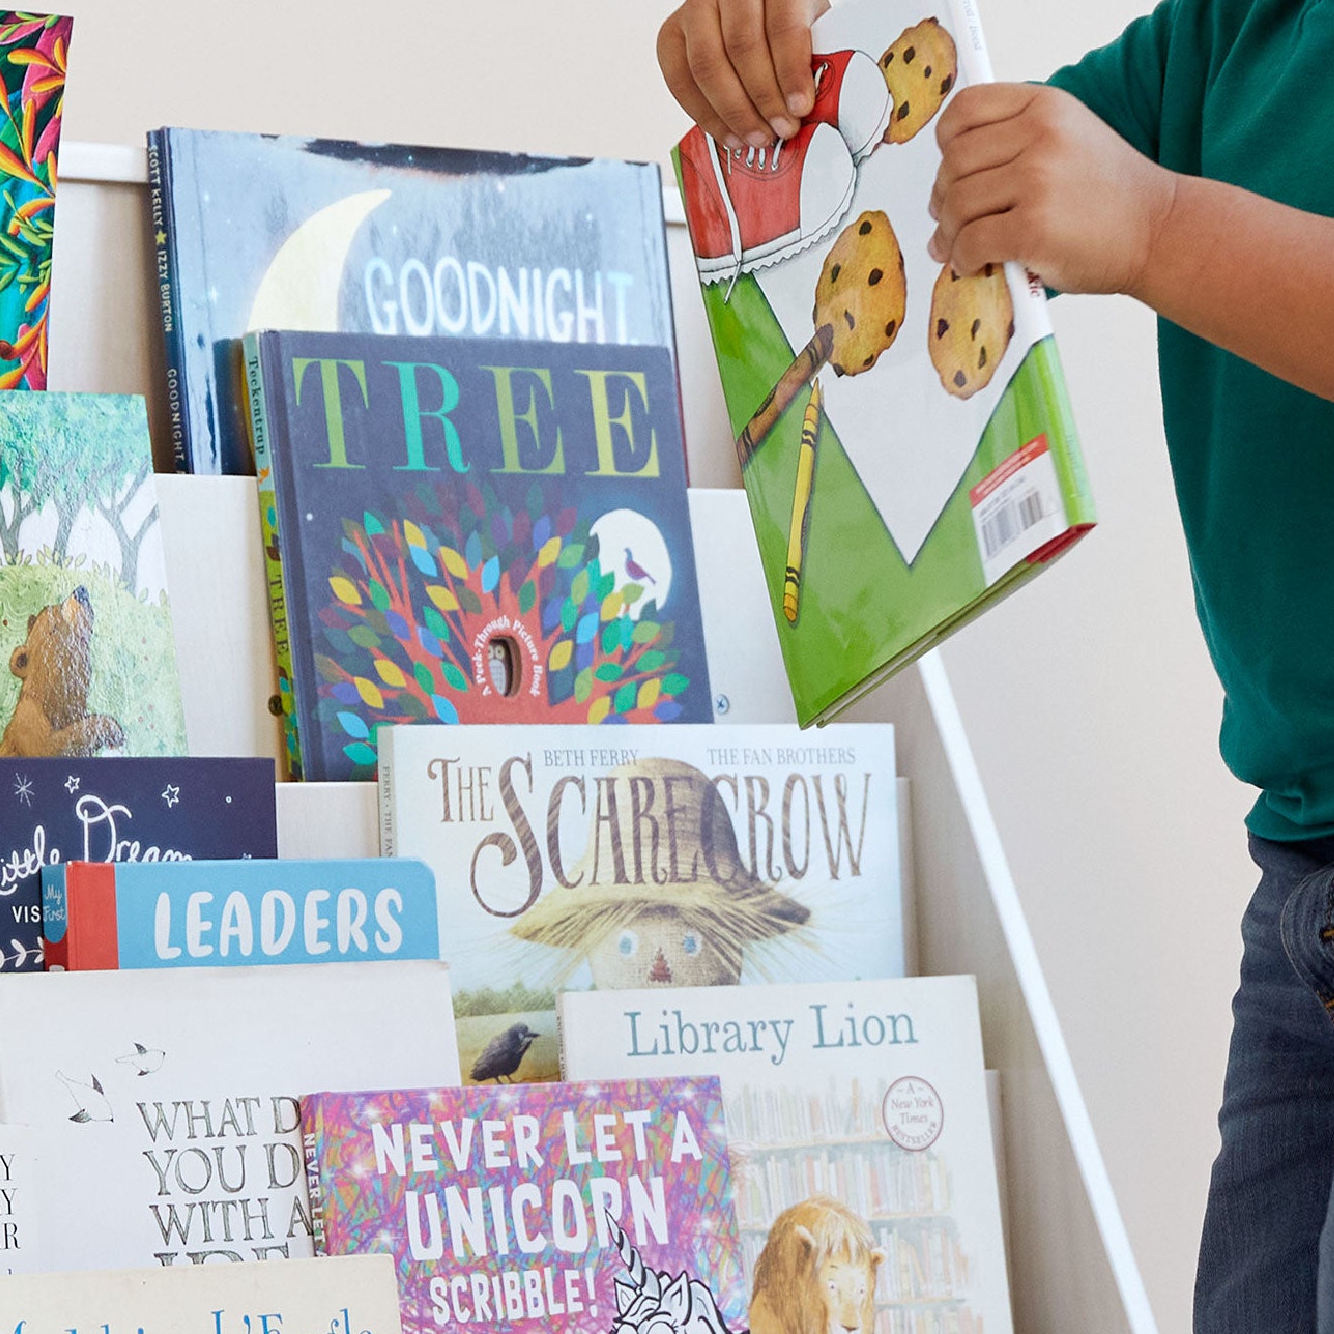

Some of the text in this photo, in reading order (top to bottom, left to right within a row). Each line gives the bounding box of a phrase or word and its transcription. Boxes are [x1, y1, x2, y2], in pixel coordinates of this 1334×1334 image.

[148, 145, 173, 332] SCOTT KELLY IZZY BURTON
[166, 368, 185, 461] GOODNIGHT
[249, 357, 264, 455] Teckentrup
[291, 356, 661, 479] TREE
[269, 573, 290, 655] TREE
[482, 685, 492, 697] A
[511, 618, 540, 662] Picture
[529, 665, 543, 697] Book
[543, 748, 640, 768] BETH FERRY
[707, 748, 856, 765] THE FAN BROTHERS
[468, 751, 874, 919] SCARECROW
[11, 904, 41, 924] VIS
[42, 904, 66, 923] First
[44, 883, 63, 906] My
[153, 886, 404, 961] LEADERS
[623, 1007, 796, 1067] Library
[807, 1000, 920, 1050] Lion
[135, 1095, 303, 1144] WHAT D
[914, 1096, 934, 1107] York
[141, 1141, 301, 1197] YOU D
[303, 1132, 322, 1200] NEVER
[370, 1108, 704, 1178] NEVER LET A
[147, 1194, 315, 1247] WITH A
[311, 1207, 325, 1244] LET
[404, 1173, 670, 1262] UNICORN
[428, 1267, 599, 1328] SCRIBBLE!
